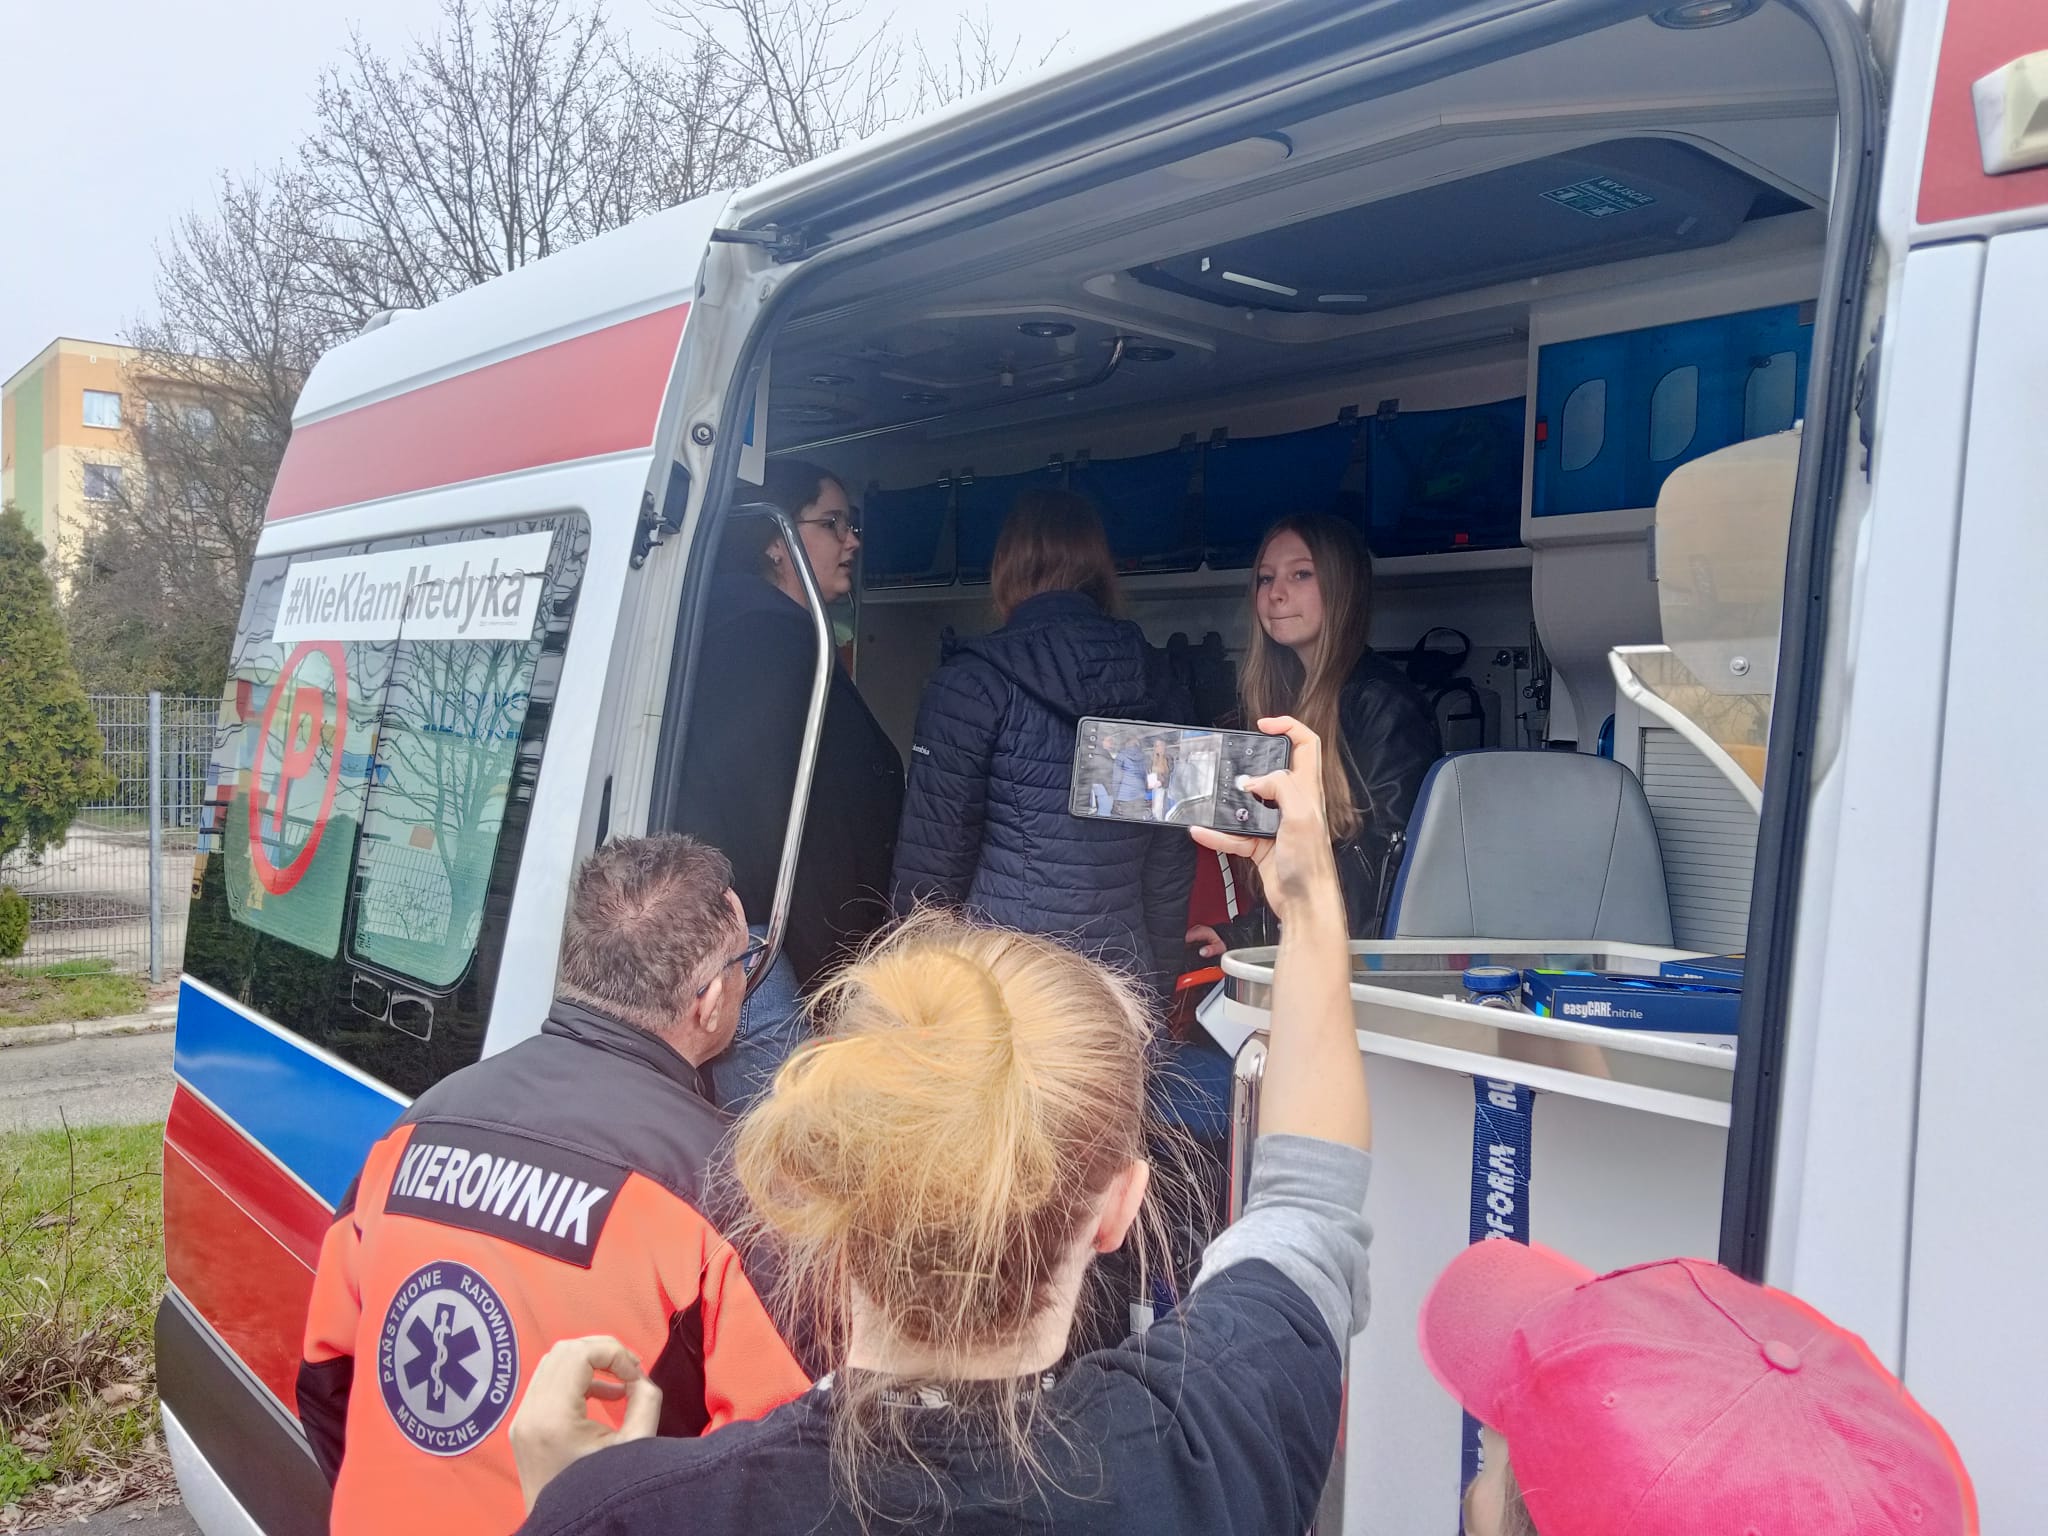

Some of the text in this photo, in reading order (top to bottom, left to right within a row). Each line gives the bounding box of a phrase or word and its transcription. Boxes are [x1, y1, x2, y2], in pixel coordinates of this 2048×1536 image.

[284, 558, 525, 634] #NieKłamMedyka
[1562, 1000, 1643, 1019] easyCARE nitrile
[392, 1143, 609, 1246] KIEROWNIK
[383, 1269, 442, 1383] PAŃSTWOWE
[460, 1275, 512, 1404] RATOWNICTWO
[397, 1404, 480, 1447] MEDYCZNE
